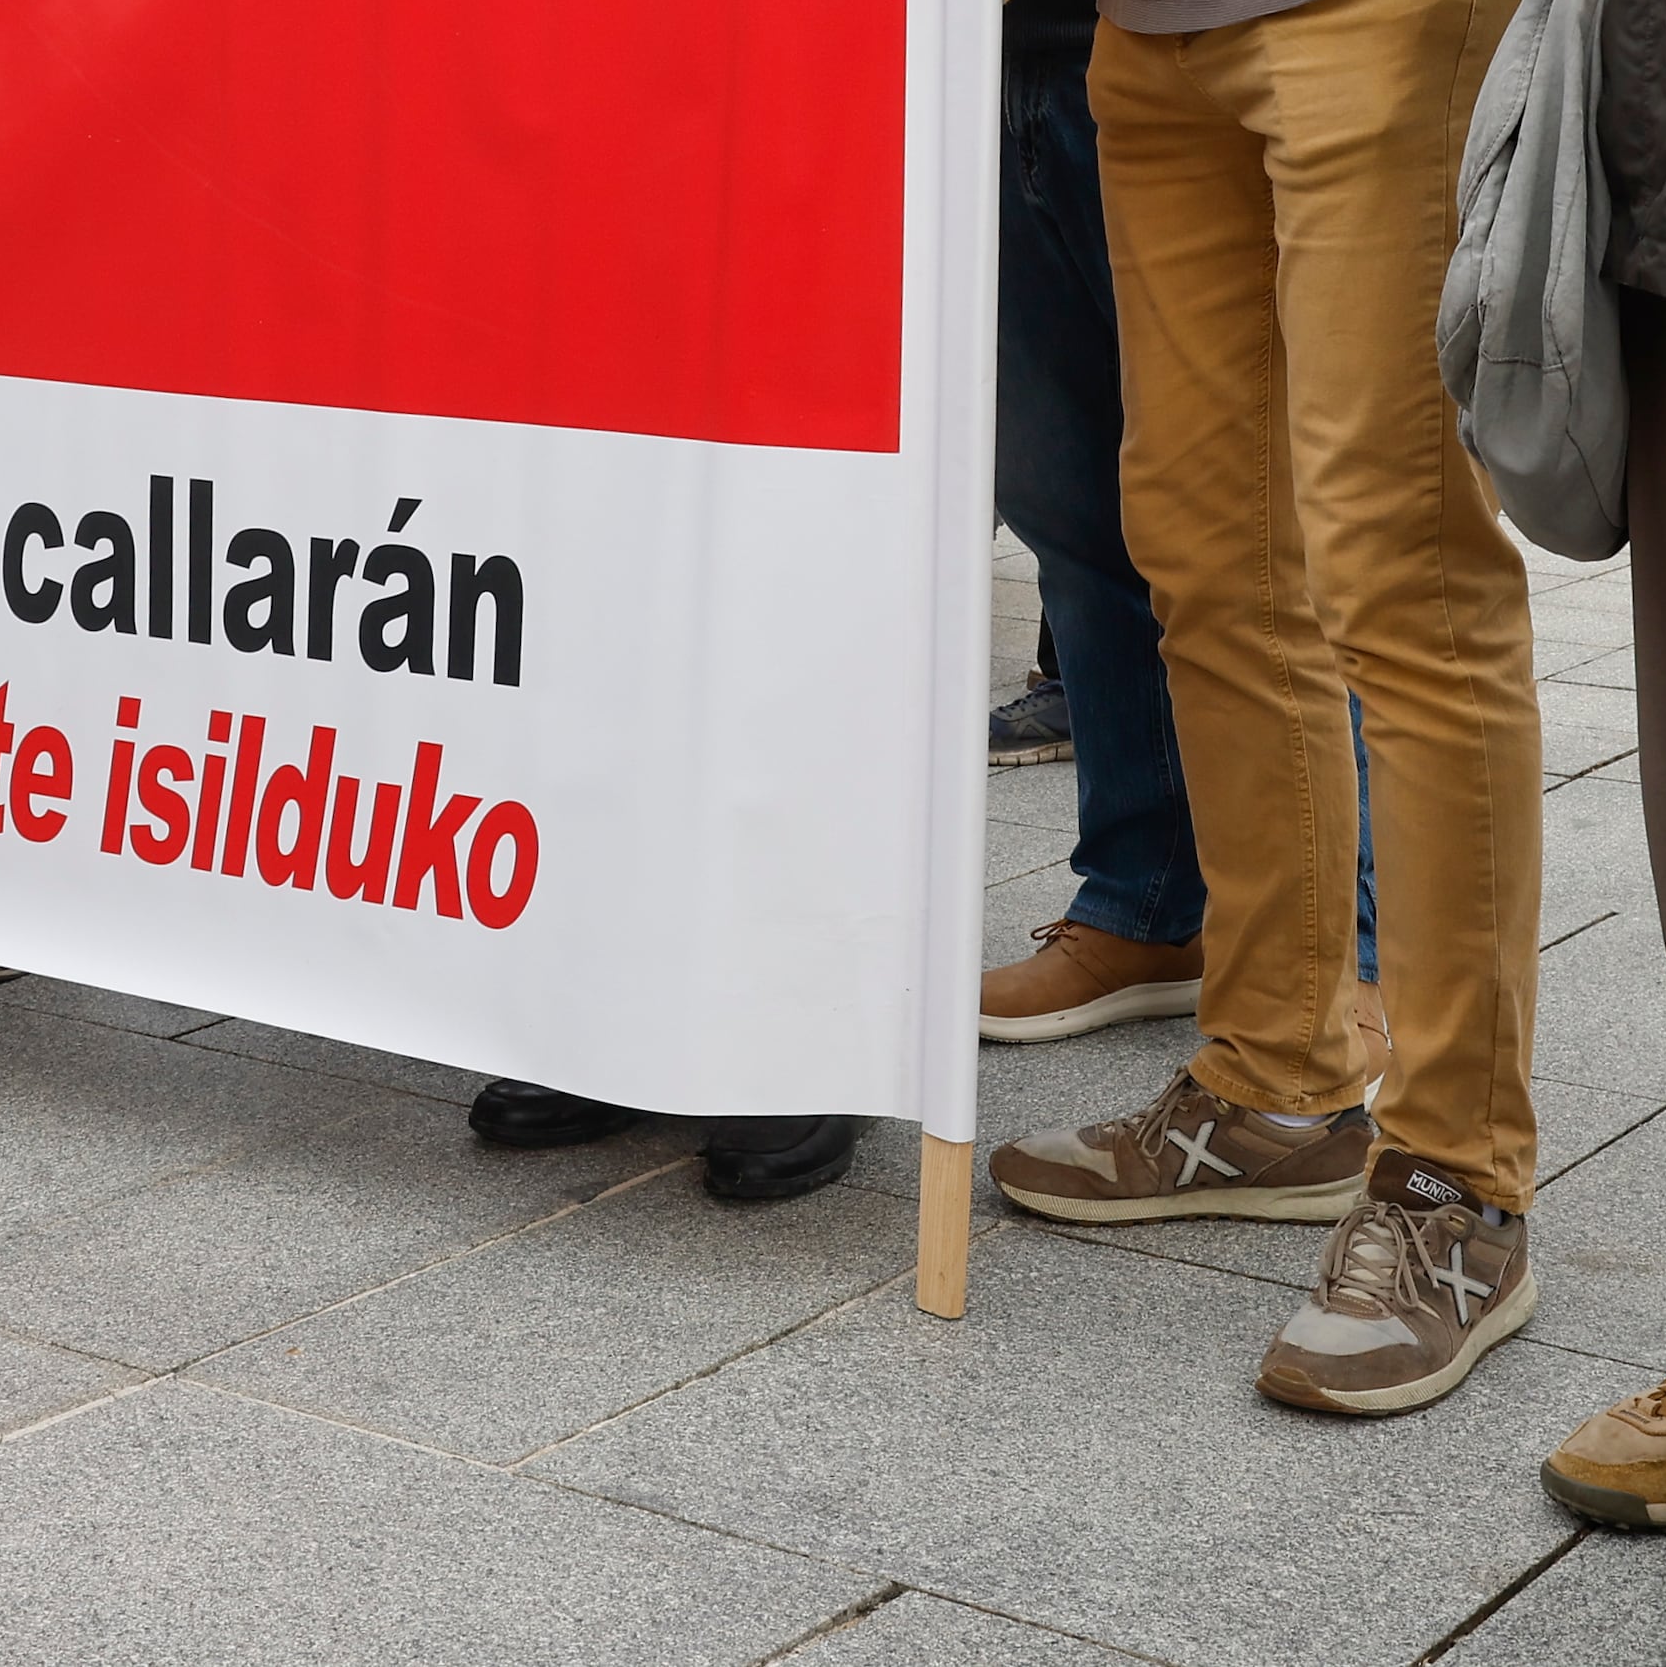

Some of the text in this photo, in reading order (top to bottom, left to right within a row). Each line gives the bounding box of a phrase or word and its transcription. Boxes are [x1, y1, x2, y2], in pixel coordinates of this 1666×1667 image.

[2, 473, 524, 688] callarán
[101, 696, 539, 930] isilduko
[1411, 1172, 1458, 1203] MUNIC
